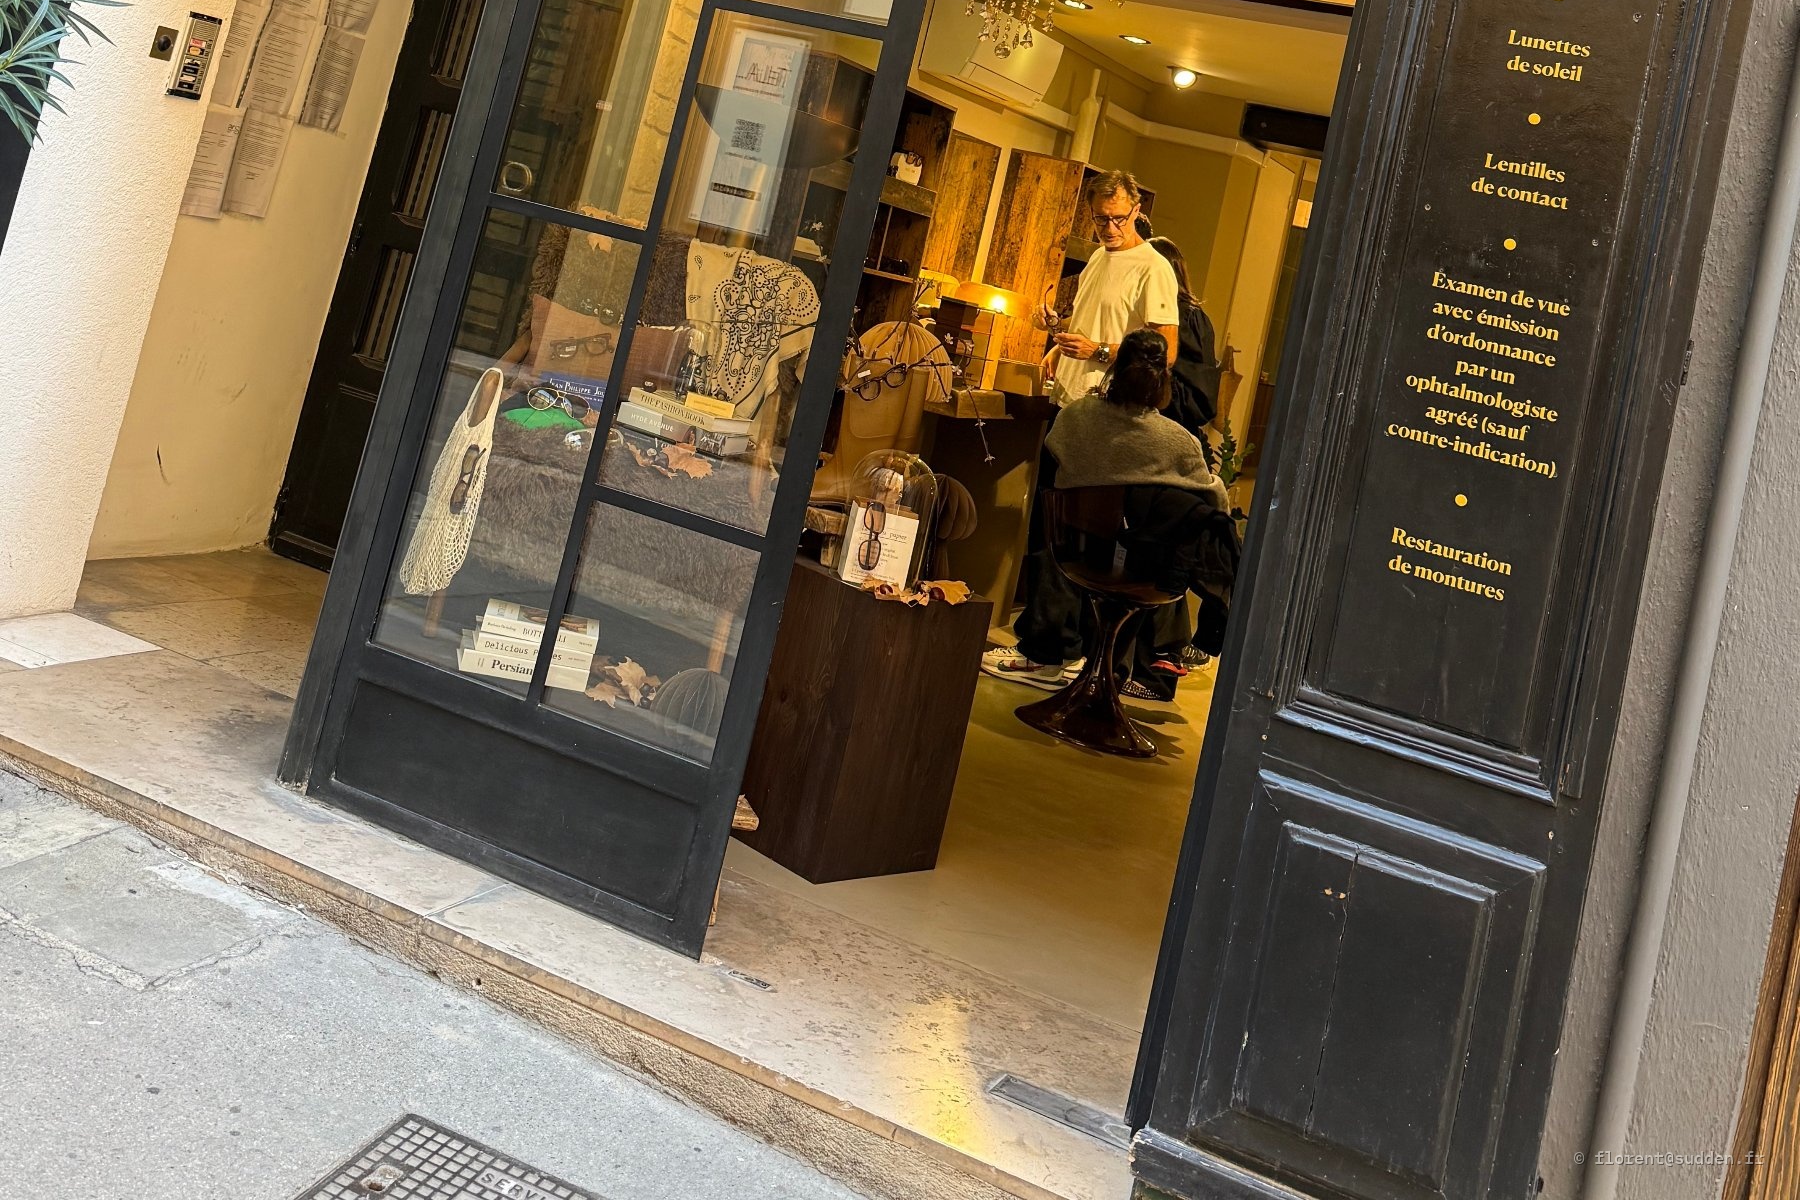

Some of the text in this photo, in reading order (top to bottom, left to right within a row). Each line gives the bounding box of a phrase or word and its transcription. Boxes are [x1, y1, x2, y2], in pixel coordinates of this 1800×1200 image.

[1508, 29, 1591, 58] Lunettes
[1506, 56, 1583, 82] de soleil
[1484, 153, 1566, 183] Lentilles
[1471, 177, 1569, 210] de contact
[1432, 271, 1571, 316] Examen de vue
[1432, 302, 1559, 341] avec émission
[1455, 359, 1515, 385] par un
[1406, 374, 1558, 421] ophtalmologiste
[631, 413, 674, 432] HYDE AVENUE
[1425, 406, 1530, 441] agréé (sauf
[1387, 423, 1556, 479] contre-indication)
[1391, 527, 1512, 576] Restauration
[1388, 555, 1505, 601] de montures
[485, 640, 528, 654] Delicious
[533, 648, 562, 660] Pes
[491, 659, 533, 676] Persian
